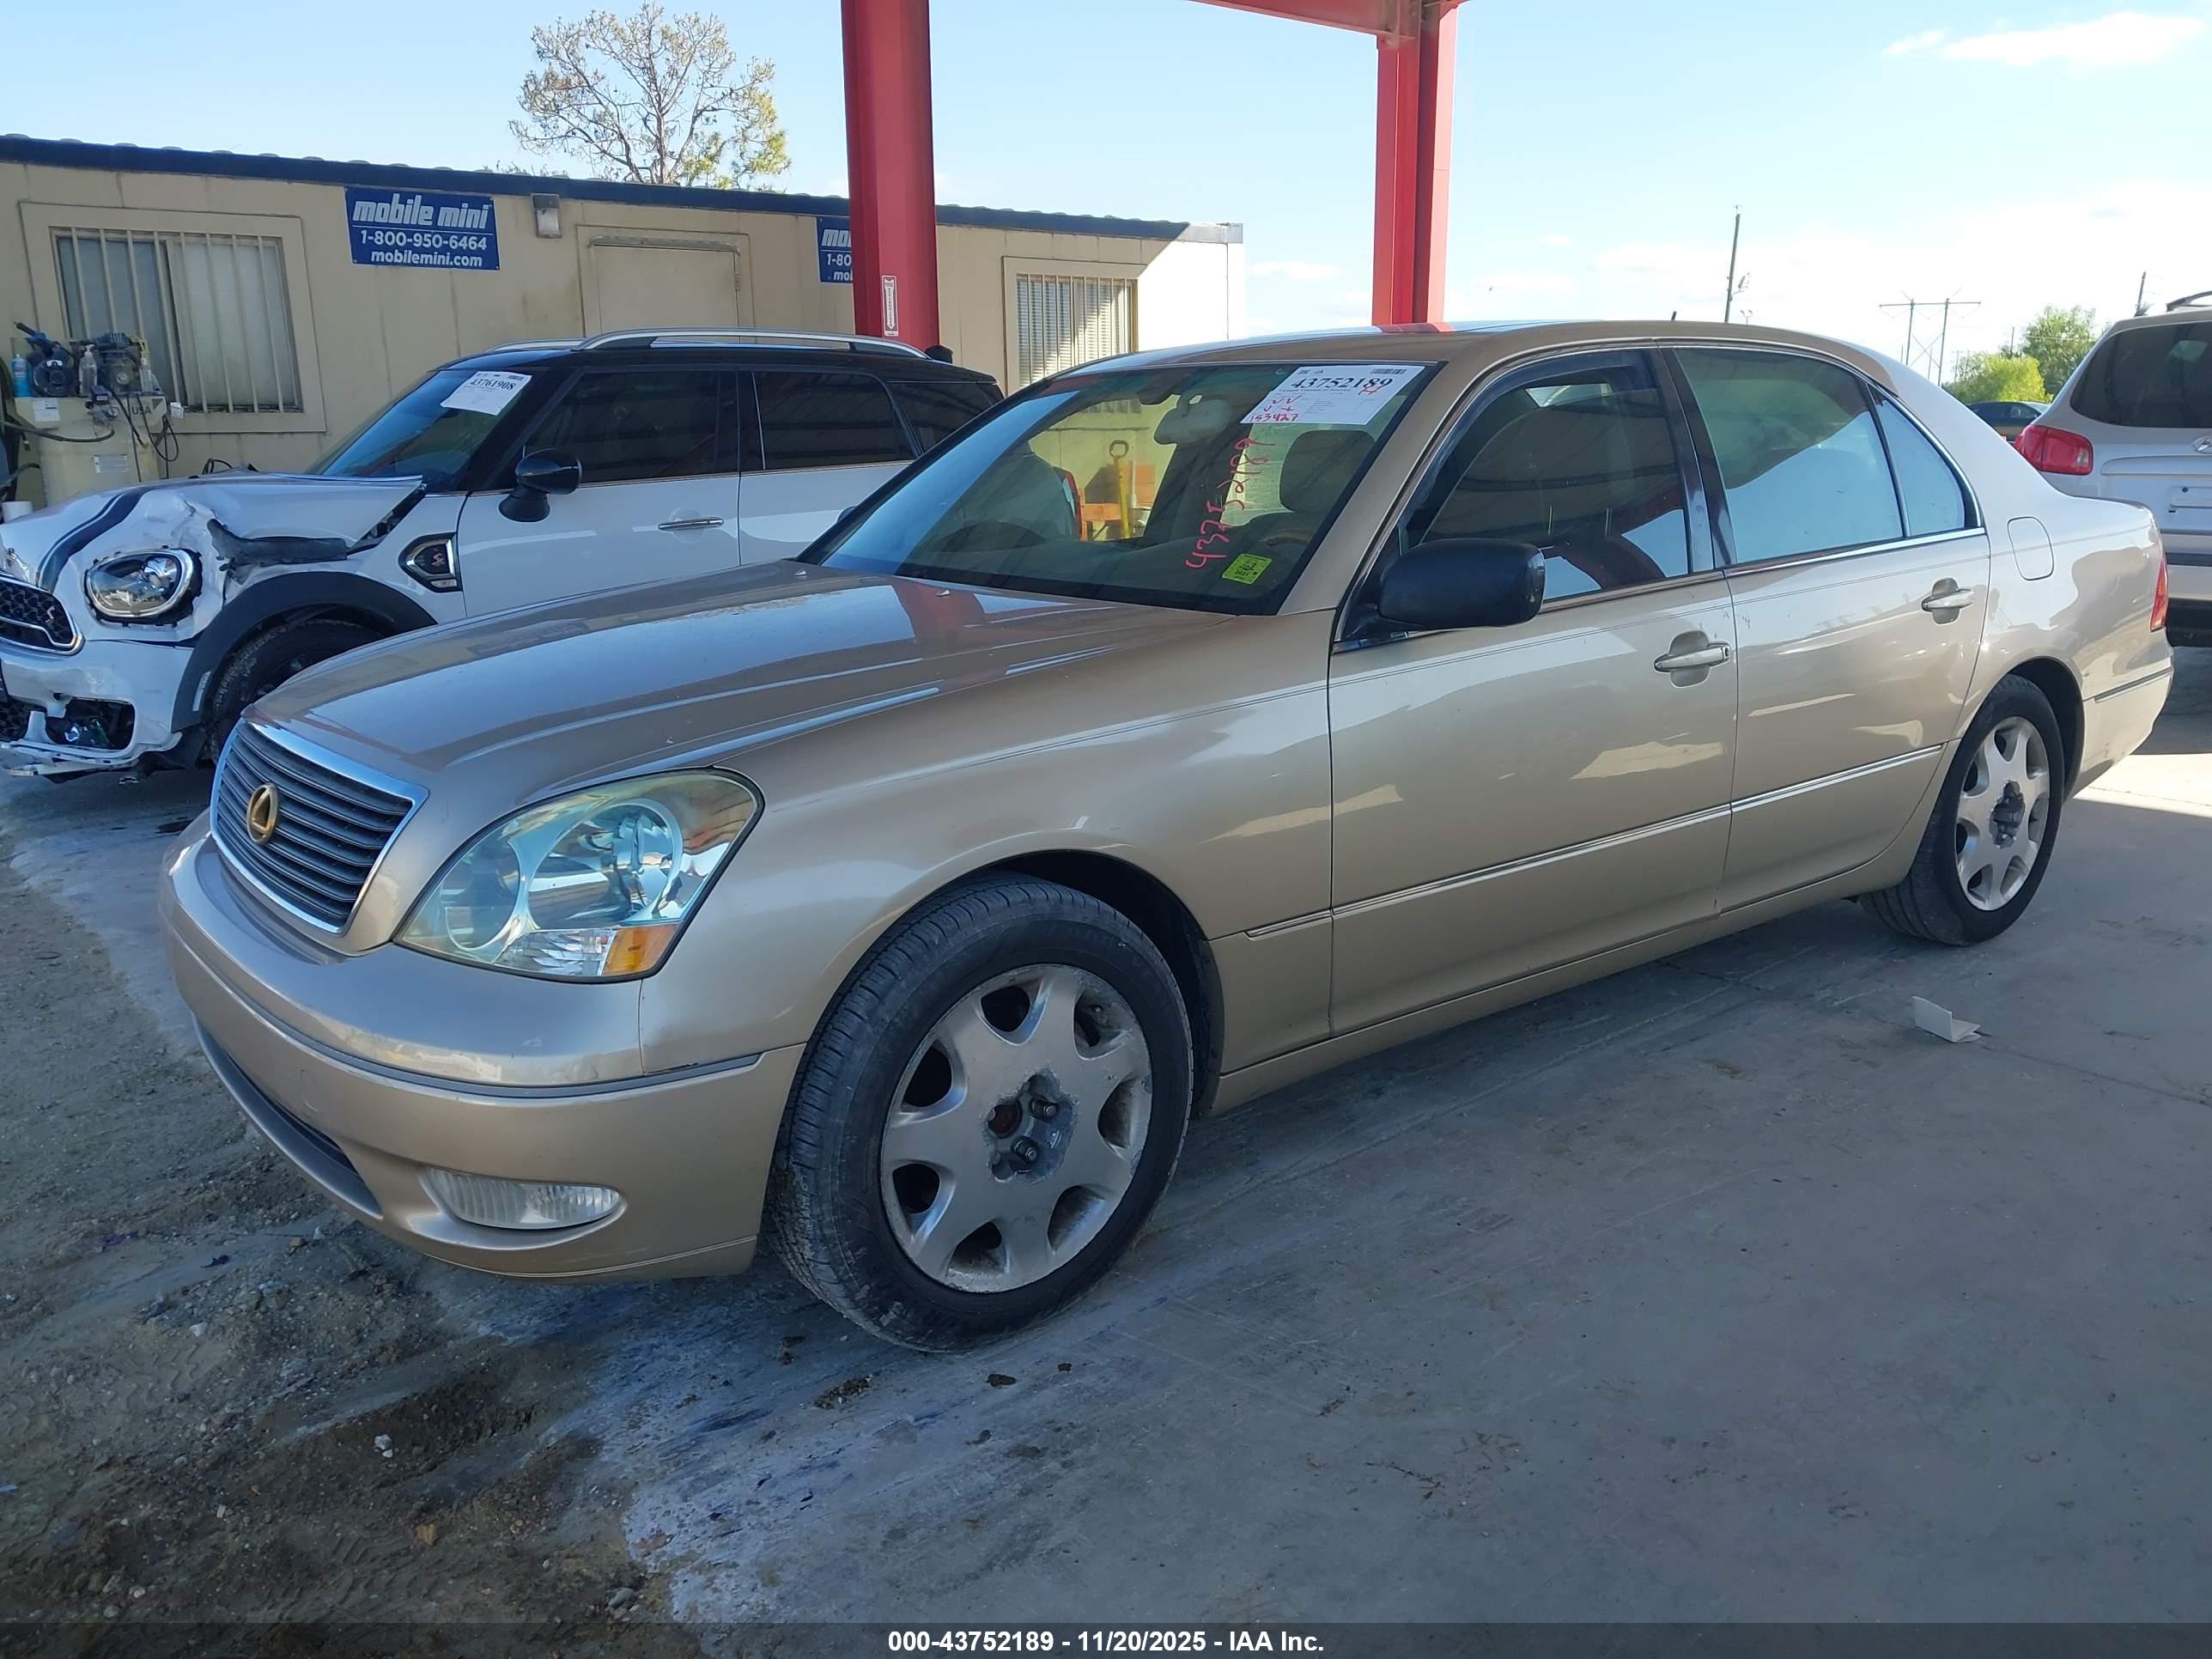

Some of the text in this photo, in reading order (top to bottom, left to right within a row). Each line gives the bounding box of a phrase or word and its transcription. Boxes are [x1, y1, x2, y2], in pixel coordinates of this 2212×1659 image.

[352, 193, 489, 229] mobile mini
[361, 229, 487, 251] 1-800-950-6464
[821, 228, 852, 247] mo
[371, 249, 483, 267] mobilemini.com
[1291, 377, 1394, 389] 43752189
